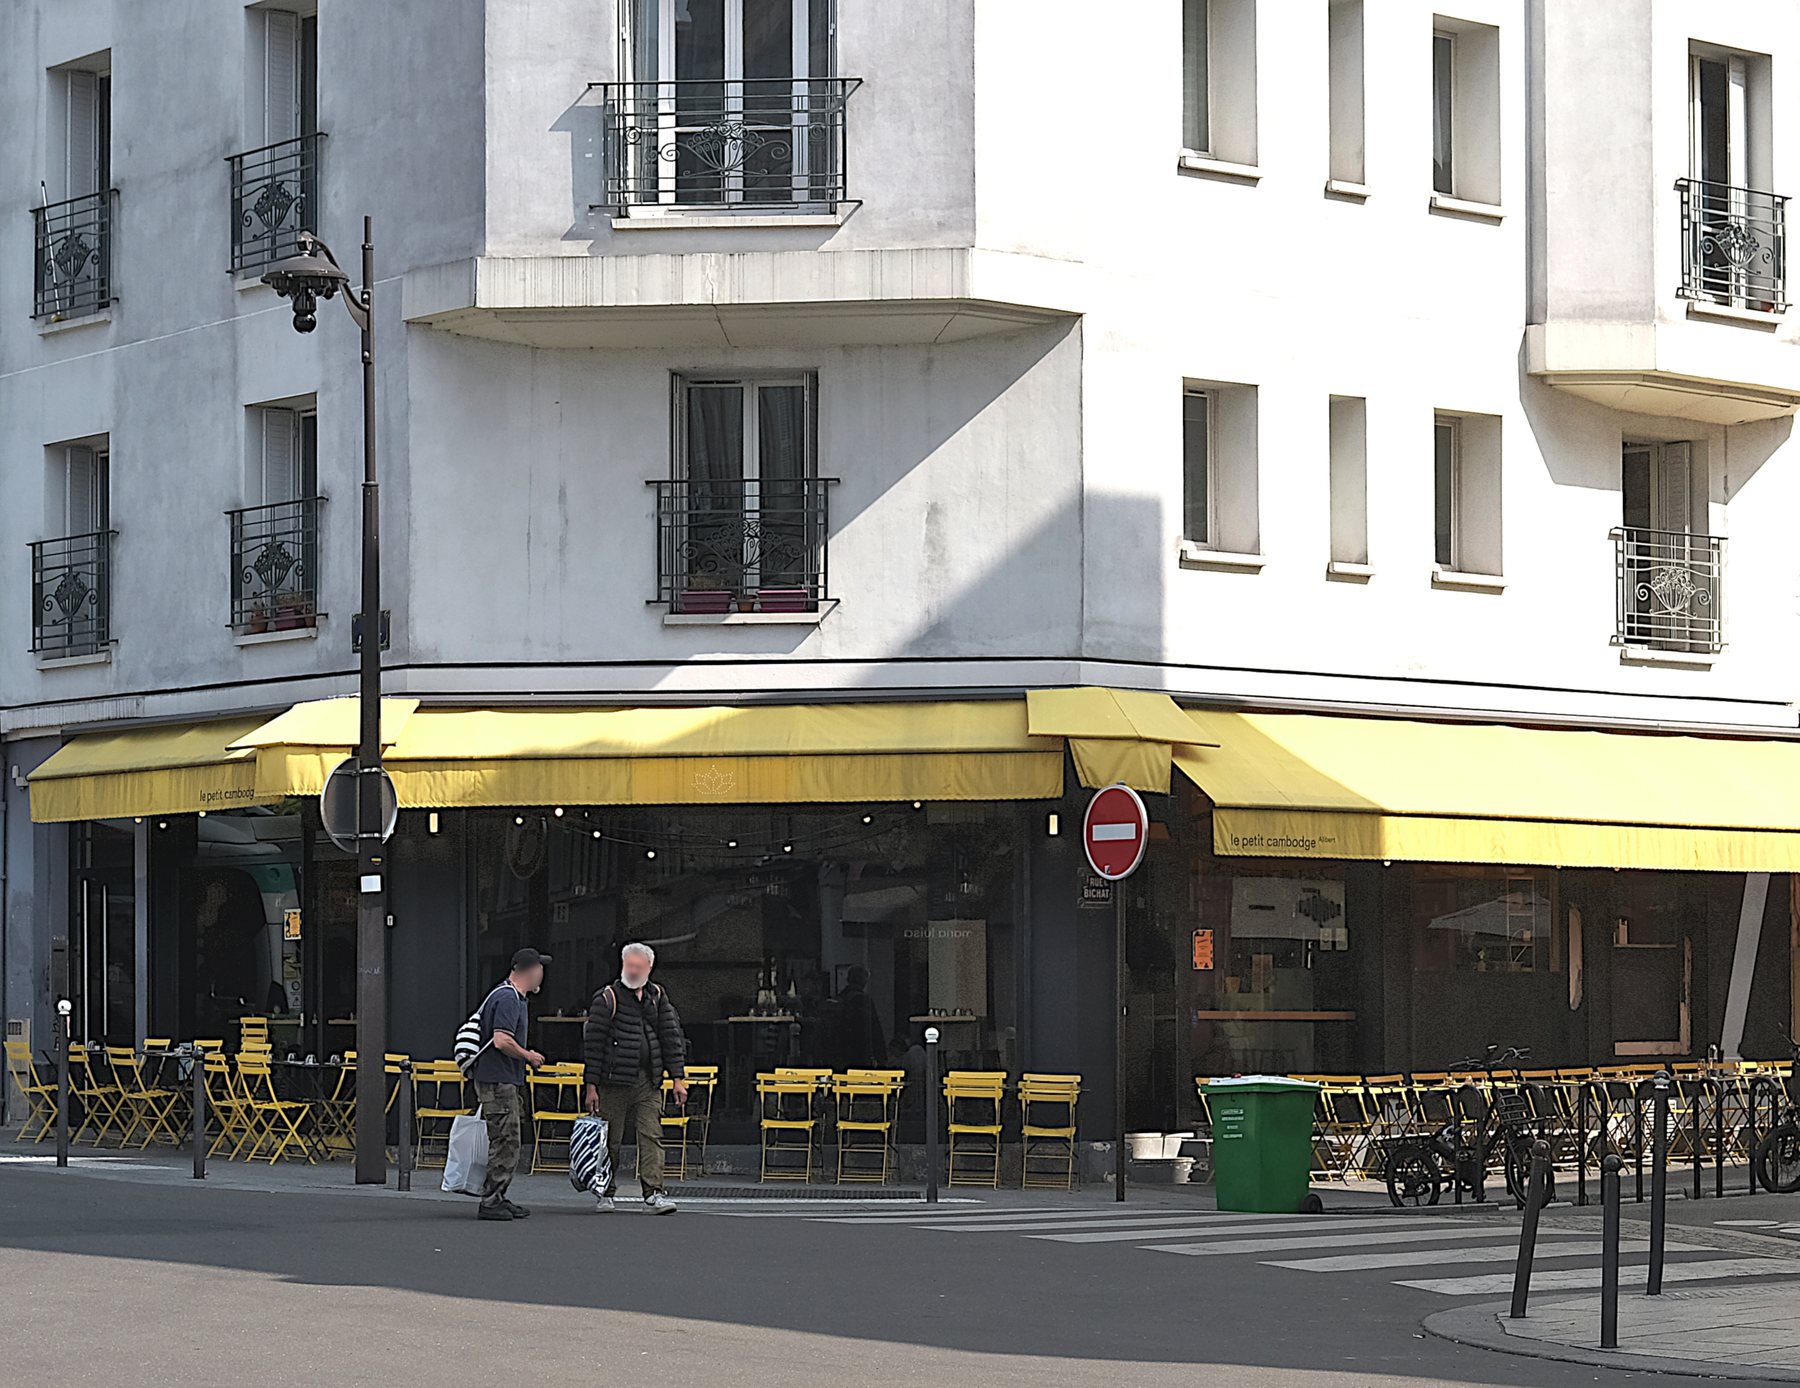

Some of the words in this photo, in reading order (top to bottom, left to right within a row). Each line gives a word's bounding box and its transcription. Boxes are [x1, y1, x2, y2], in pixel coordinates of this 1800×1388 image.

[200, 790, 206, 802] le
[207, 789, 223, 803] petit
[224, 787, 254, 800] cambodg
[1230, 833, 1239, 846] le
[1242, 833, 1264, 849] petit
[1267, 835, 1316, 851] cambodge
[1090, 877, 1103, 887] RUE
[1083, 888, 1110, 898] BICHAT
